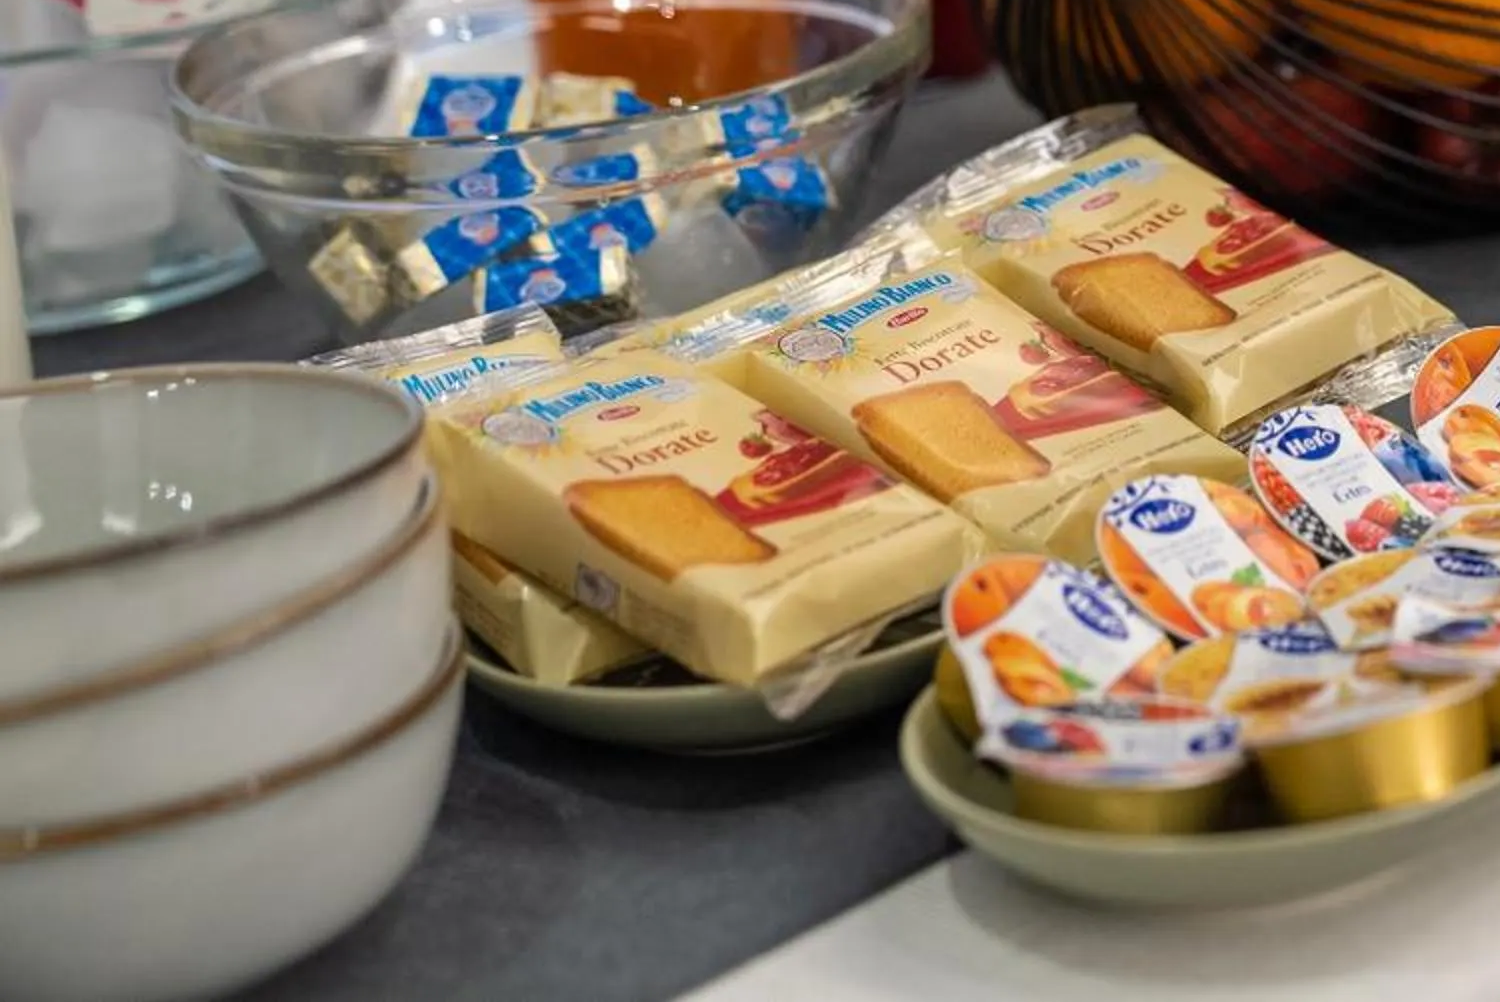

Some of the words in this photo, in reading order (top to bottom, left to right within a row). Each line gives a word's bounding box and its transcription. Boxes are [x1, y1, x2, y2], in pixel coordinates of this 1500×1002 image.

[1078, 203, 1187, 255] Dorate
[818, 292, 891, 333] MULINO
[881, 273, 952, 304] BIANCO
[882, 329, 1001, 383] Dorate
[595, 426, 719, 475] Dorate
[1286, 428, 1338, 458] Hero
[1138, 501, 1190, 530] Hero
